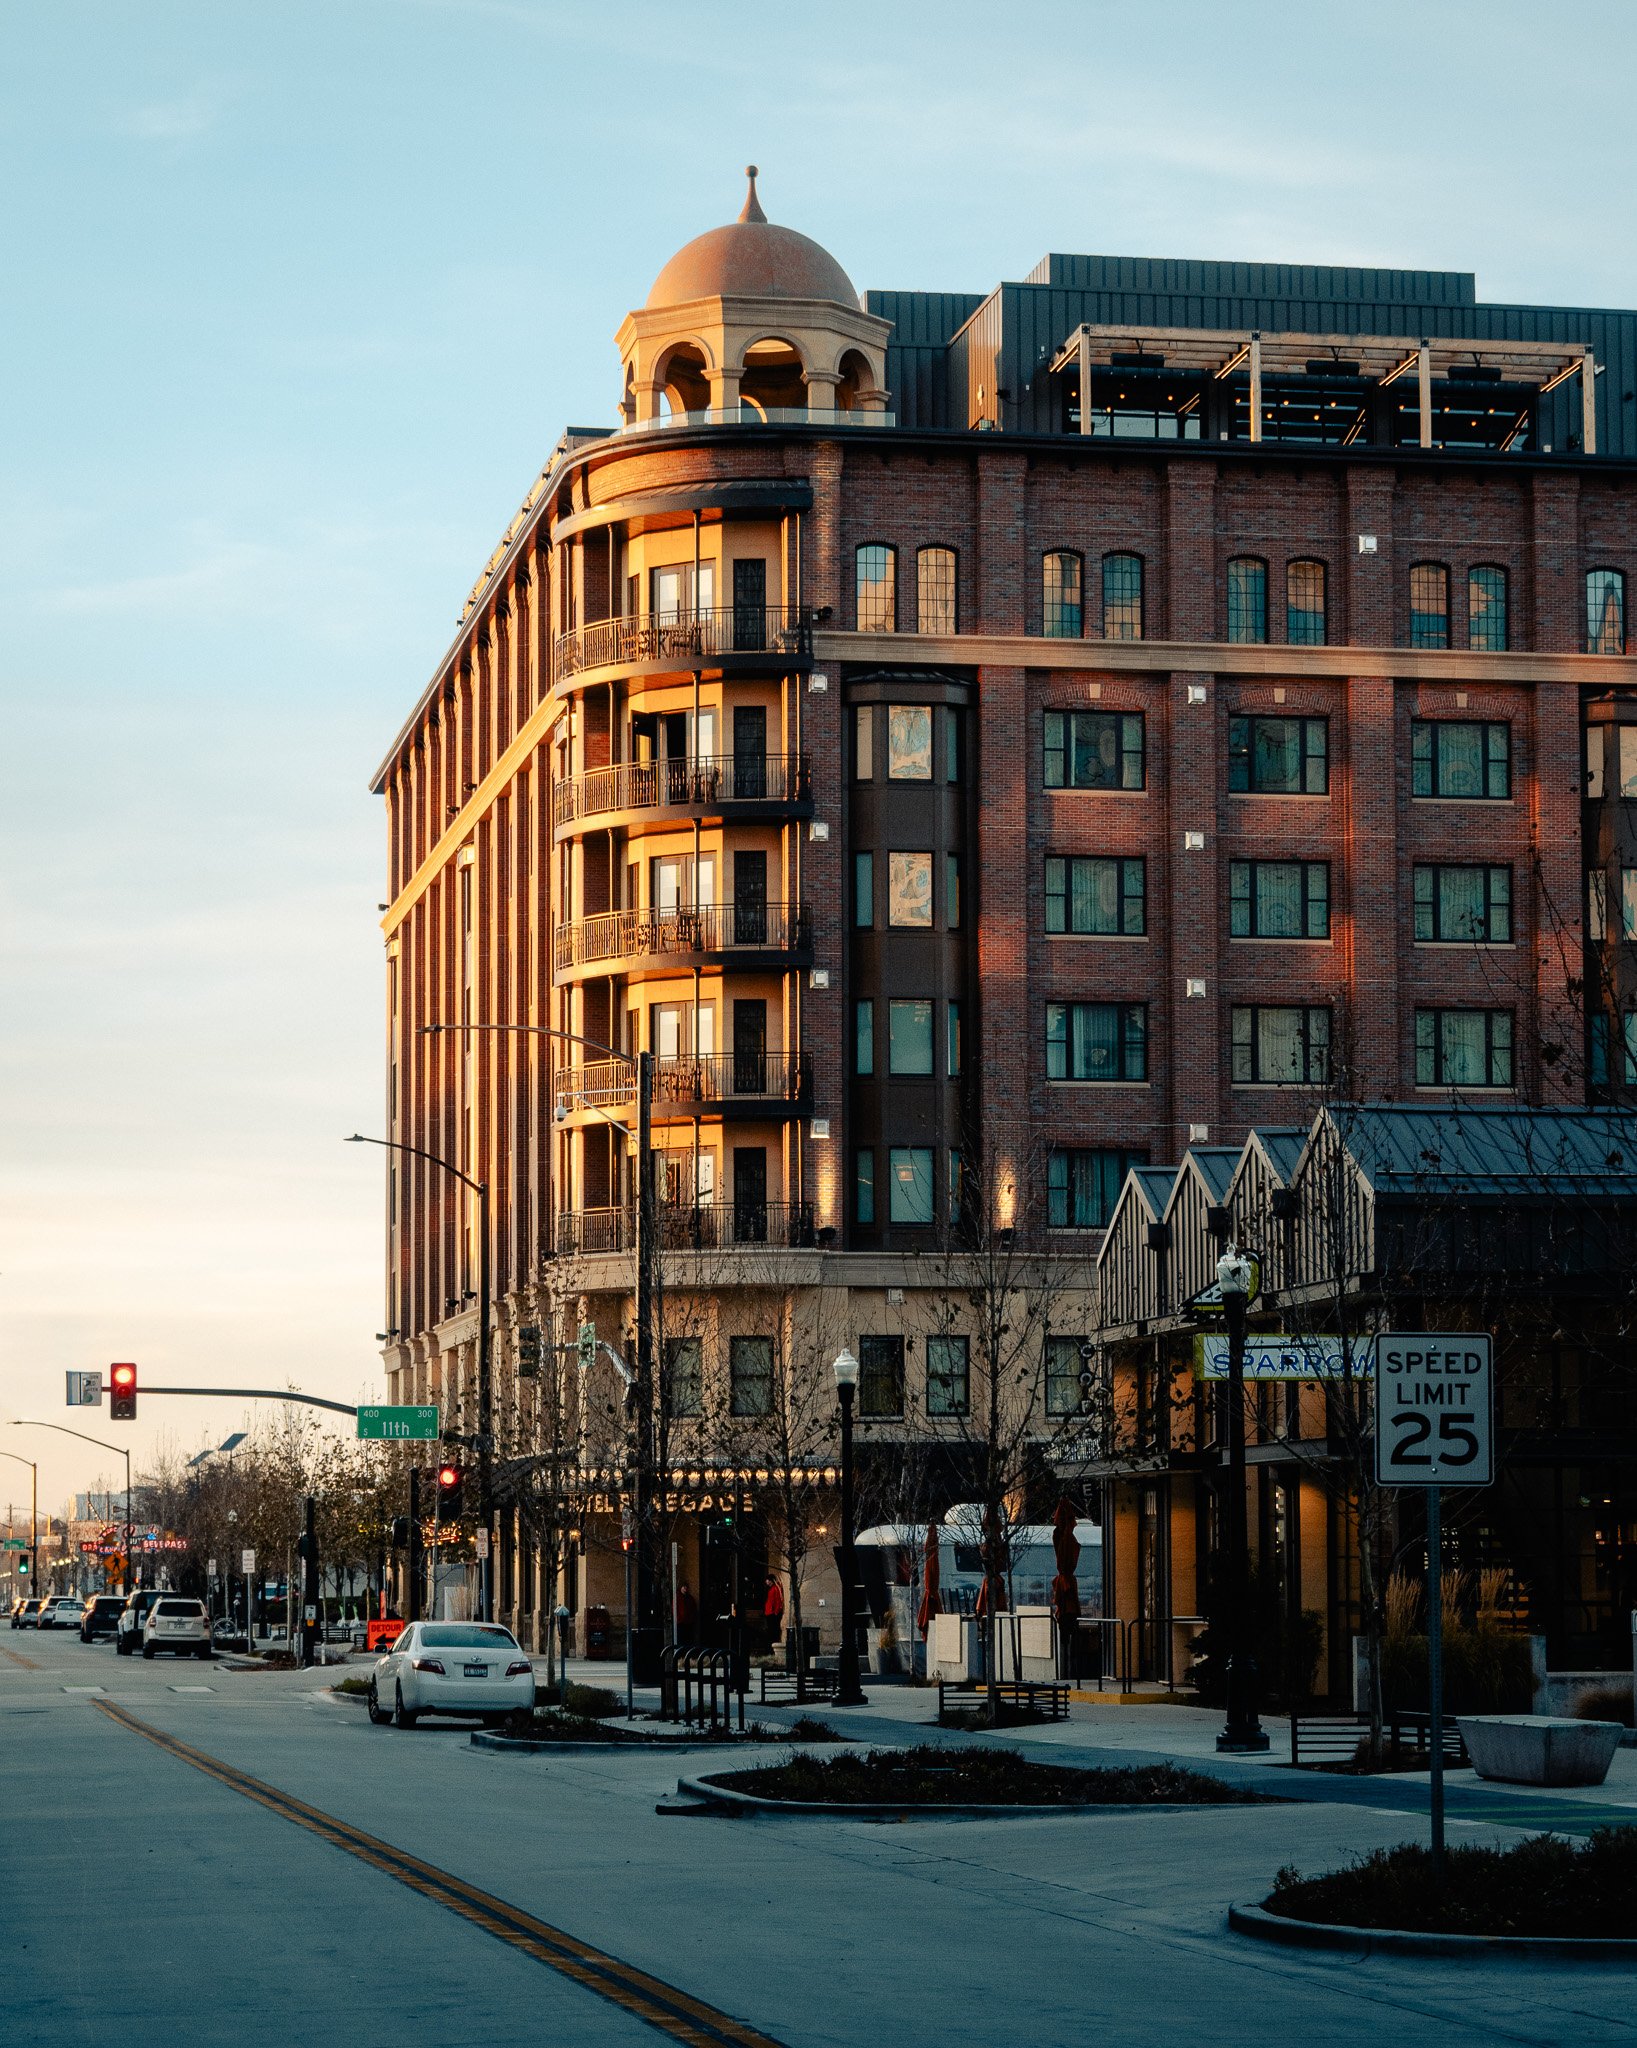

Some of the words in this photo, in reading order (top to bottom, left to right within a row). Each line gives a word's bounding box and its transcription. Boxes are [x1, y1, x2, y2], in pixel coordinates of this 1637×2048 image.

[1386, 1352, 1481, 1374] SPEED
[1397, 1383, 1471, 1405] LIMIT
[363, 1409, 379, 1418] 400
[417, 1409, 433, 1418] 300
[363, 1428, 368, 1436] S
[382, 1421, 410, 1436] 11th
[425, 1428, 433, 1436] St
[1390, 1412, 1479, 1466] 25
[618, 1493, 753, 1513] RNEGADE
[371, 1623, 402, 1632] DETOUR
